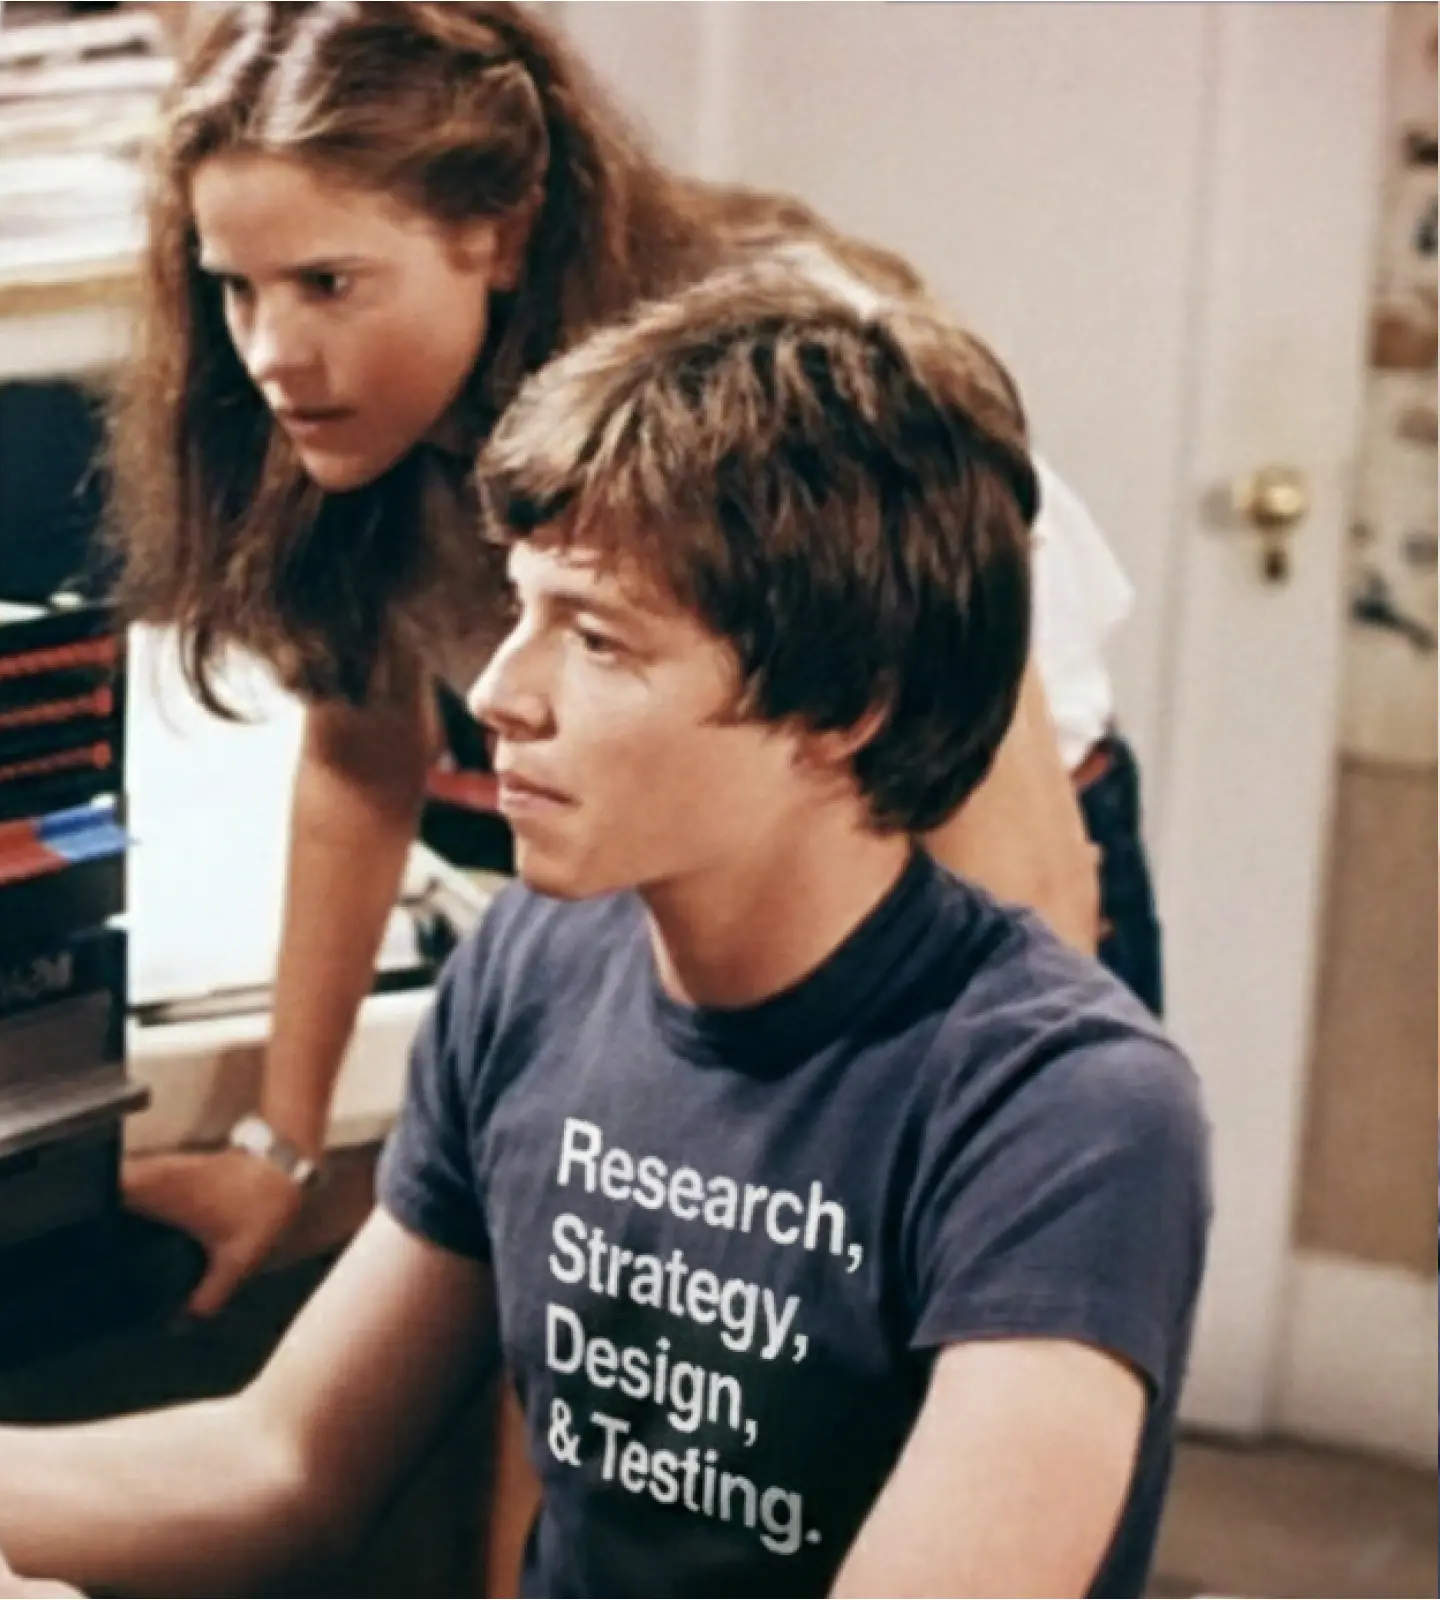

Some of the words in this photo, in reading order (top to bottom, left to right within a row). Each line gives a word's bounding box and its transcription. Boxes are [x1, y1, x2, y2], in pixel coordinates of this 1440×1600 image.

[557, 1116, 864, 1274] Research,
[548, 1212, 809, 1362] Strategy,
[546, 1302, 758, 1447] Design,
[547, 1397, 582, 1467] &
[590, 1411, 822, 1555] Testing.
